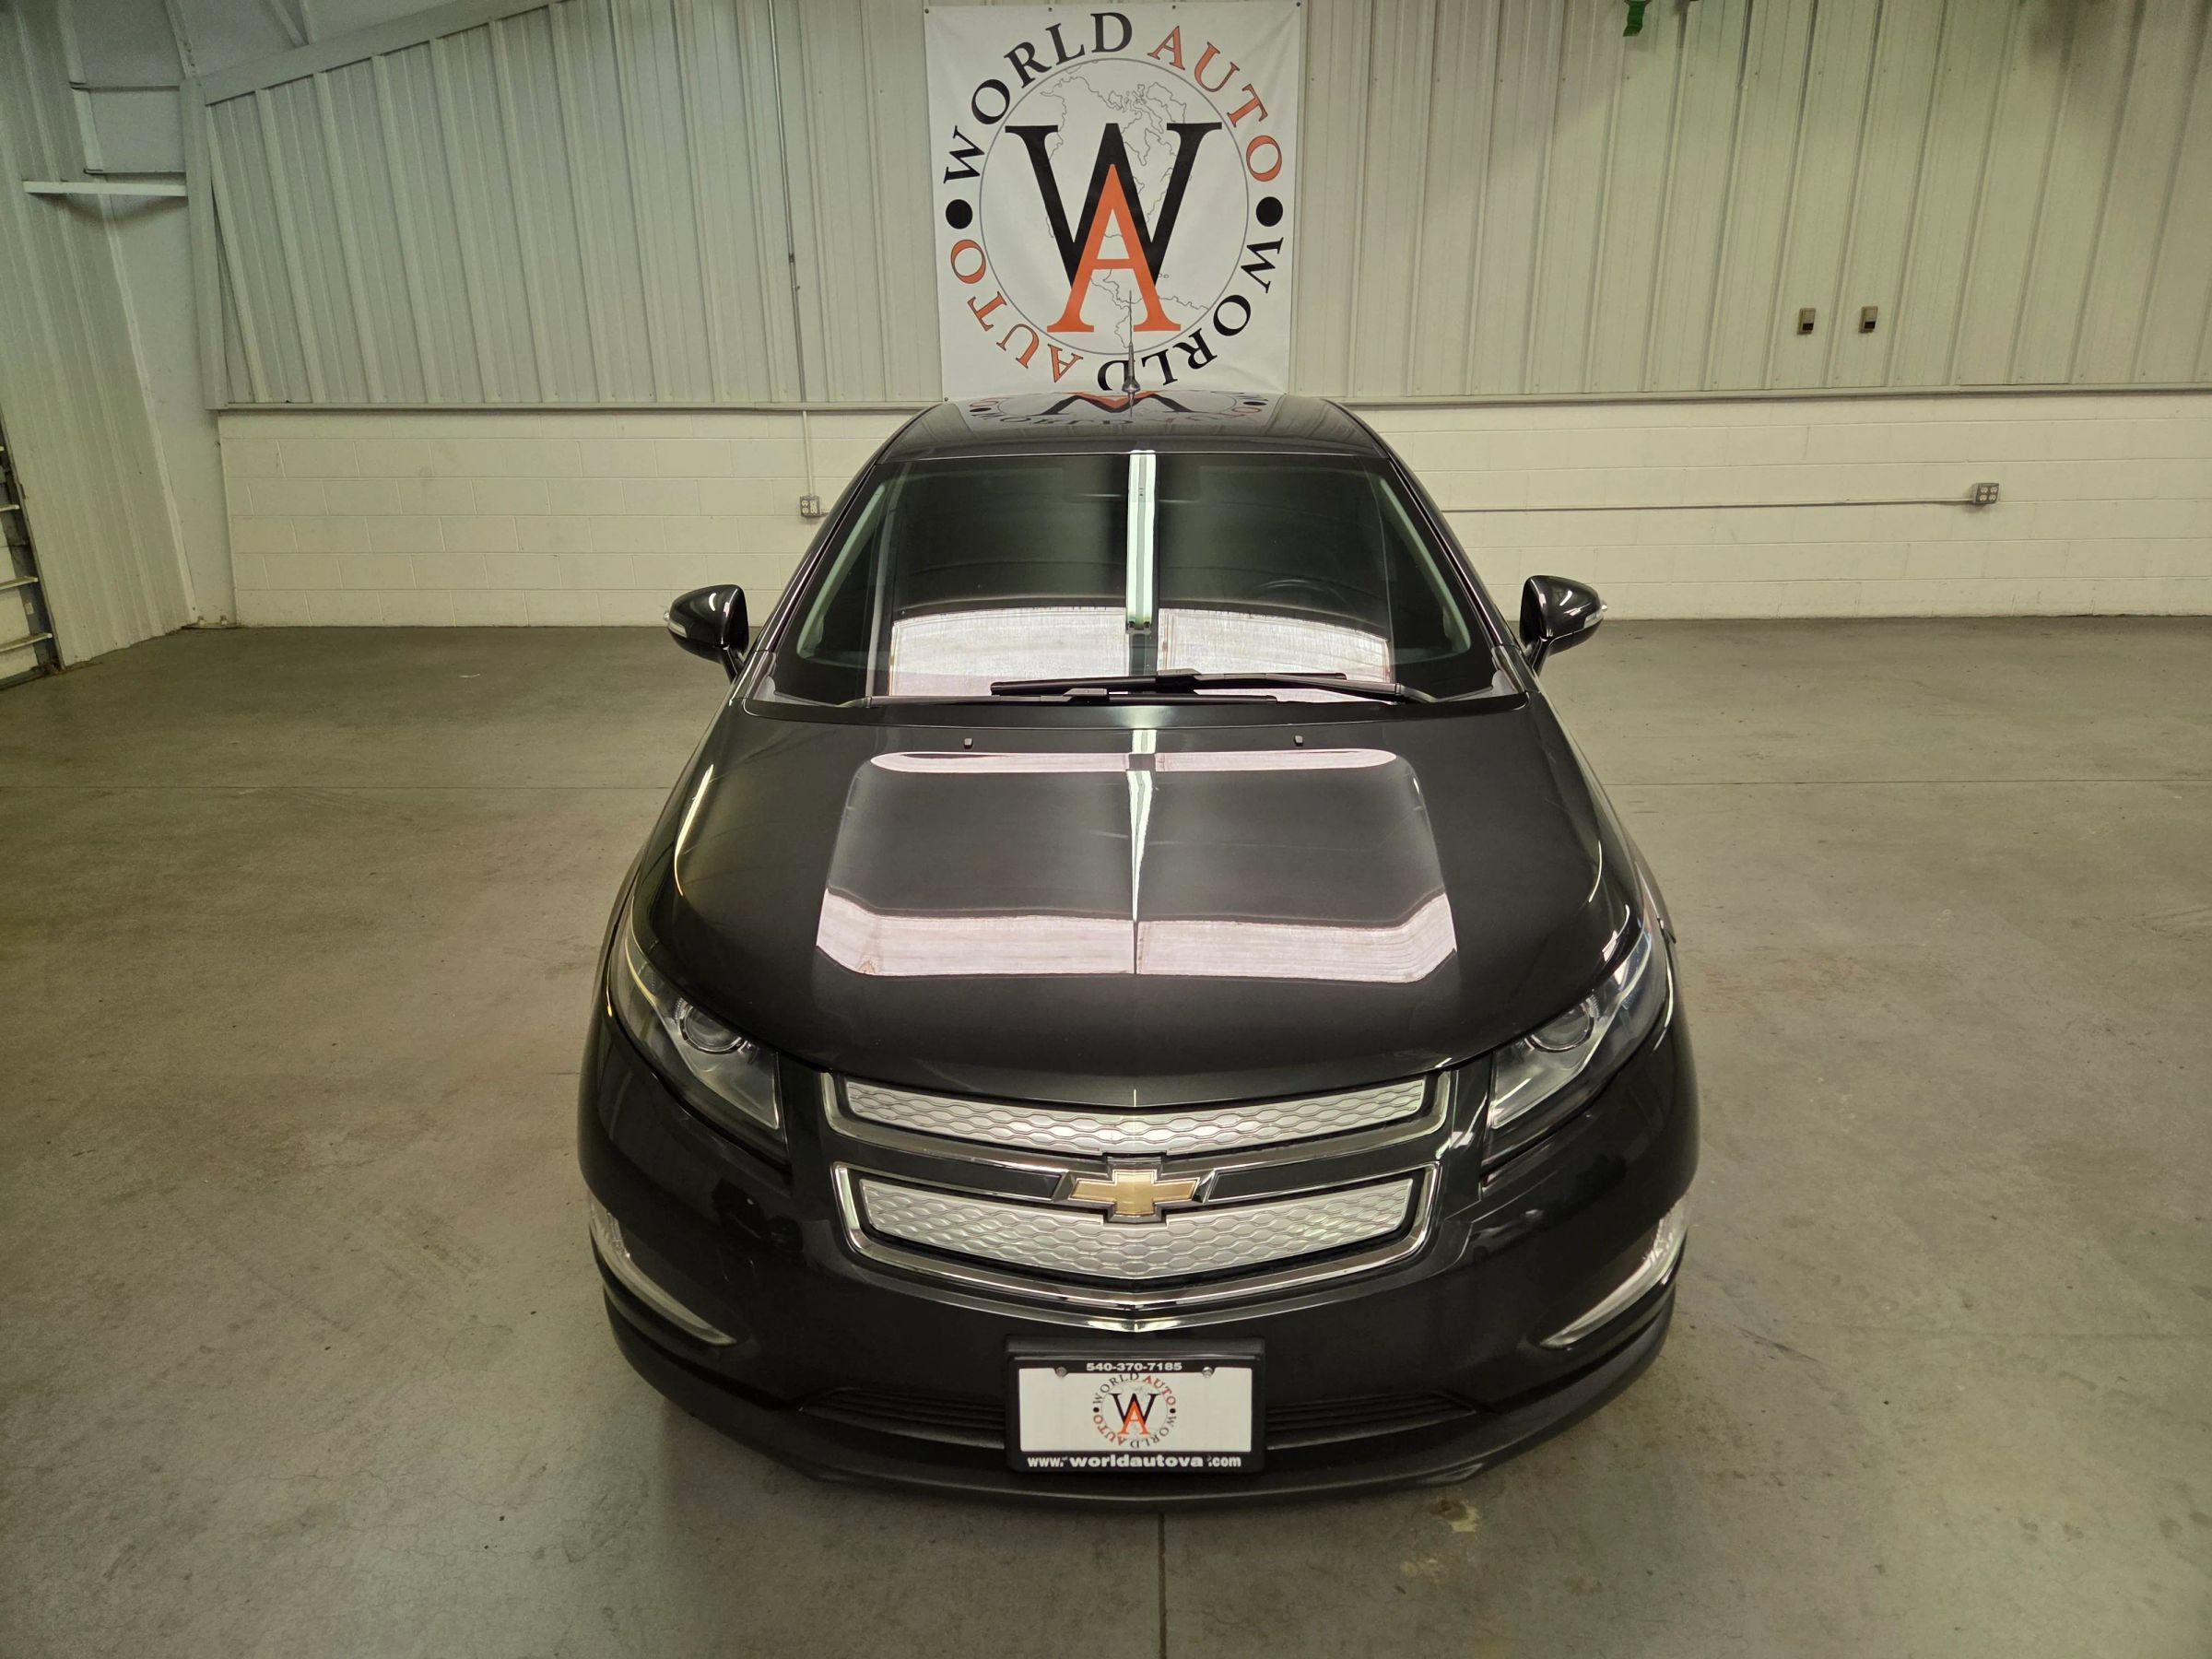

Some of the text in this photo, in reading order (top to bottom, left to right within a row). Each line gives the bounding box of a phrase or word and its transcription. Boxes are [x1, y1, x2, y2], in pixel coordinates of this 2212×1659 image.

[944, 12, 1282, 183] WORLD AUTO
[950, 237, 1284, 391] WORLD AUTO
[1087, 1362, 1182, 1371] 540-370-7185
[1092, 1372, 1176, 1406] WORLD AUTO
